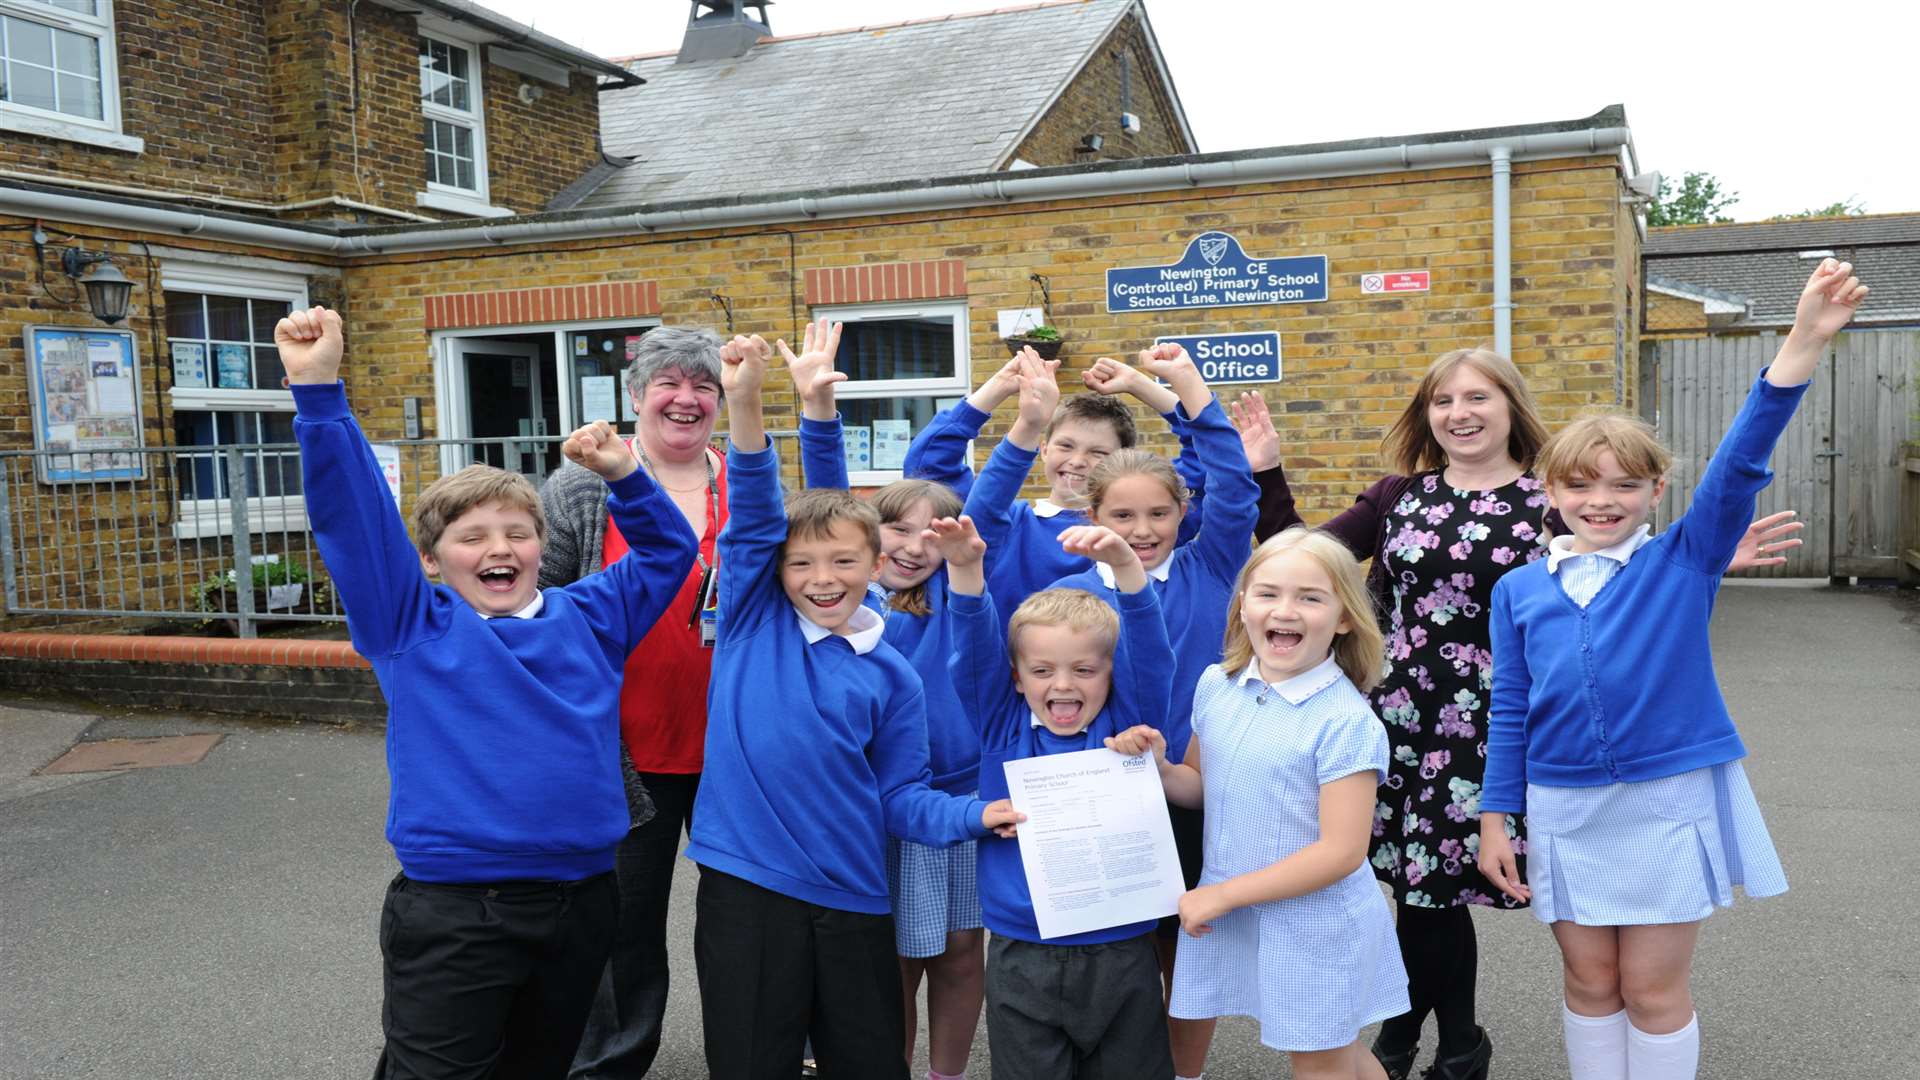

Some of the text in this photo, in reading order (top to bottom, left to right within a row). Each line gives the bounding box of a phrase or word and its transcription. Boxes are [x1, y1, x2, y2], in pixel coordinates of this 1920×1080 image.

[1160, 263, 1268, 281] Newington CE
[1113, 273, 1319, 297] (Controlled) Primary School
[1129, 295, 1176, 307] School
[1225, 288, 1304, 303] Newington
[1196, 340, 1273, 359] School
[1202, 361, 1268, 379] Office
[1122, 758, 1147, 768] Ofsted
